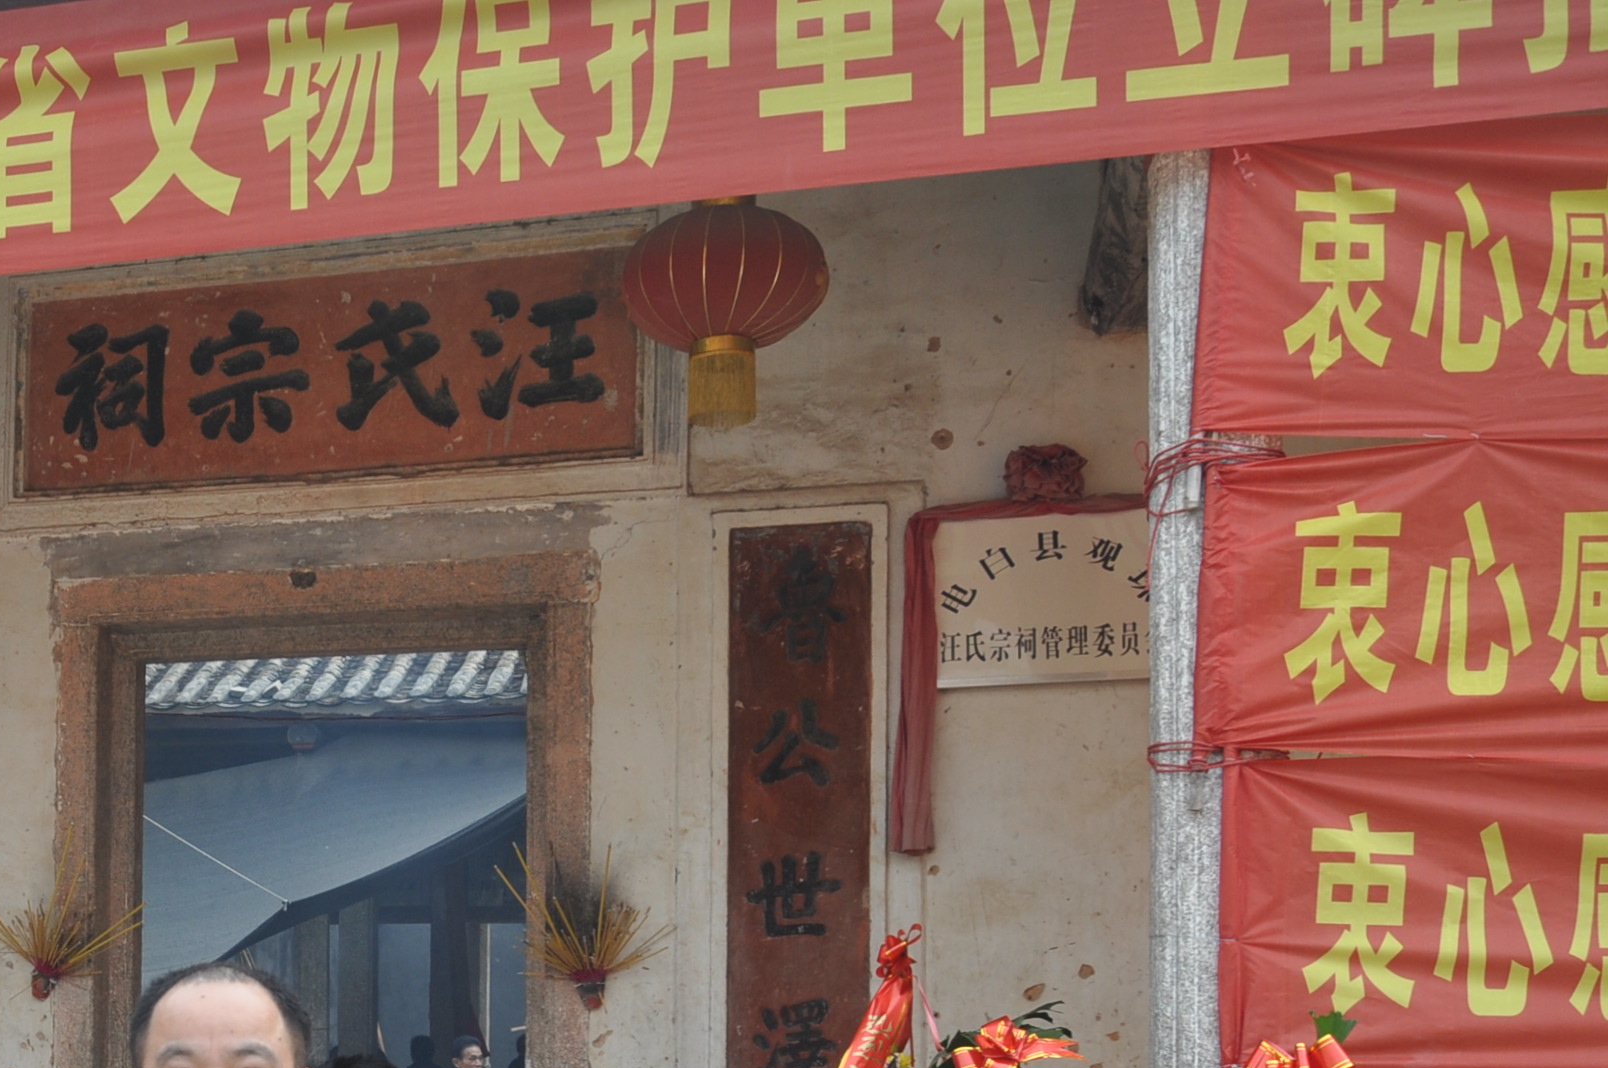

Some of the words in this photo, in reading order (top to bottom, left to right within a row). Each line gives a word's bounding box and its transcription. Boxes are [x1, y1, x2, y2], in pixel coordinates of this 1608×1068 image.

[940, 621, 1149, 664] 汪氏宗祠管理委员
